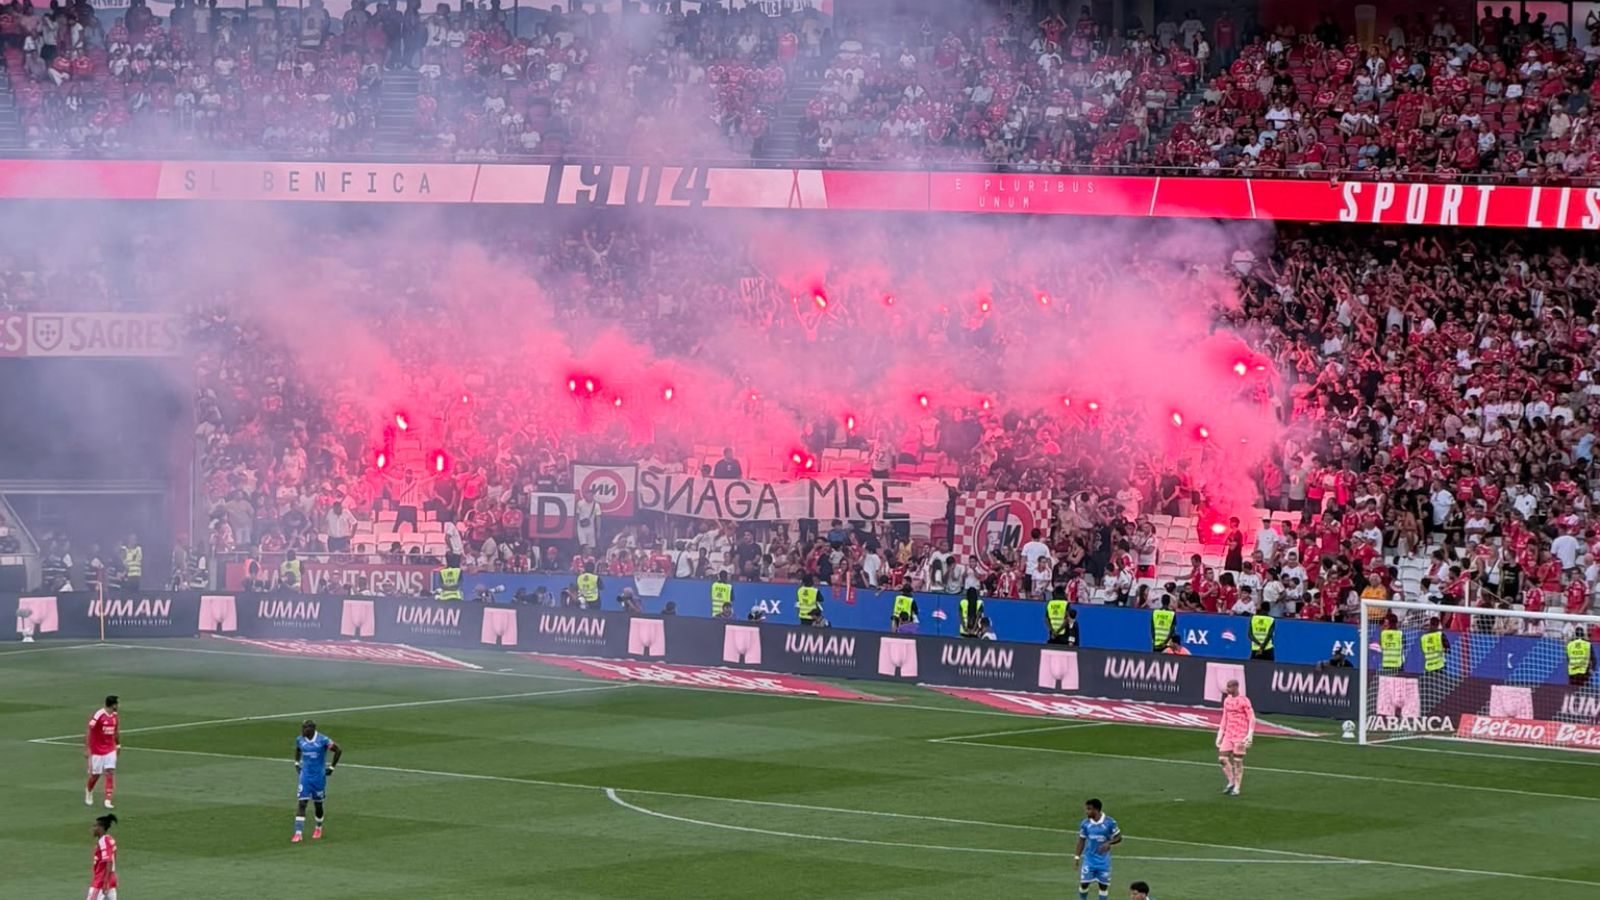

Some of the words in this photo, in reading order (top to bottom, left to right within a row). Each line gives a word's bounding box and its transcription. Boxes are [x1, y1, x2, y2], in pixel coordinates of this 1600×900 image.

[184, 170, 221, 191] SL
[263, 171, 430, 194] BENFICA
[955, 179, 961, 190] E
[984, 180, 1094, 193] PLURIBUS
[979, 196, 1030, 208] UNUM
[1340, 182, 1496, 226] SPORT
[1527, 186, 1600, 230] LIS
[0, 316, 22, 351] S
[69, 316, 179, 351] SAGRES
[808, 478, 911, 520] MIŠE
[536, 496, 568, 534] D
[88, 599, 171, 617] IUMAN
[257, 600, 320, 619] IUMAN
[396, 605, 460, 626] IUMAN
[539, 614, 606, 637] IUMAN
[785, 633, 855, 656] IUMAN
[941, 645, 1014, 669] IUMAN
[1104, 658, 1179, 682] IUMAN
[1272, 670, 1349, 697] IUMAN
[1472, 716, 1545, 740] Betano
